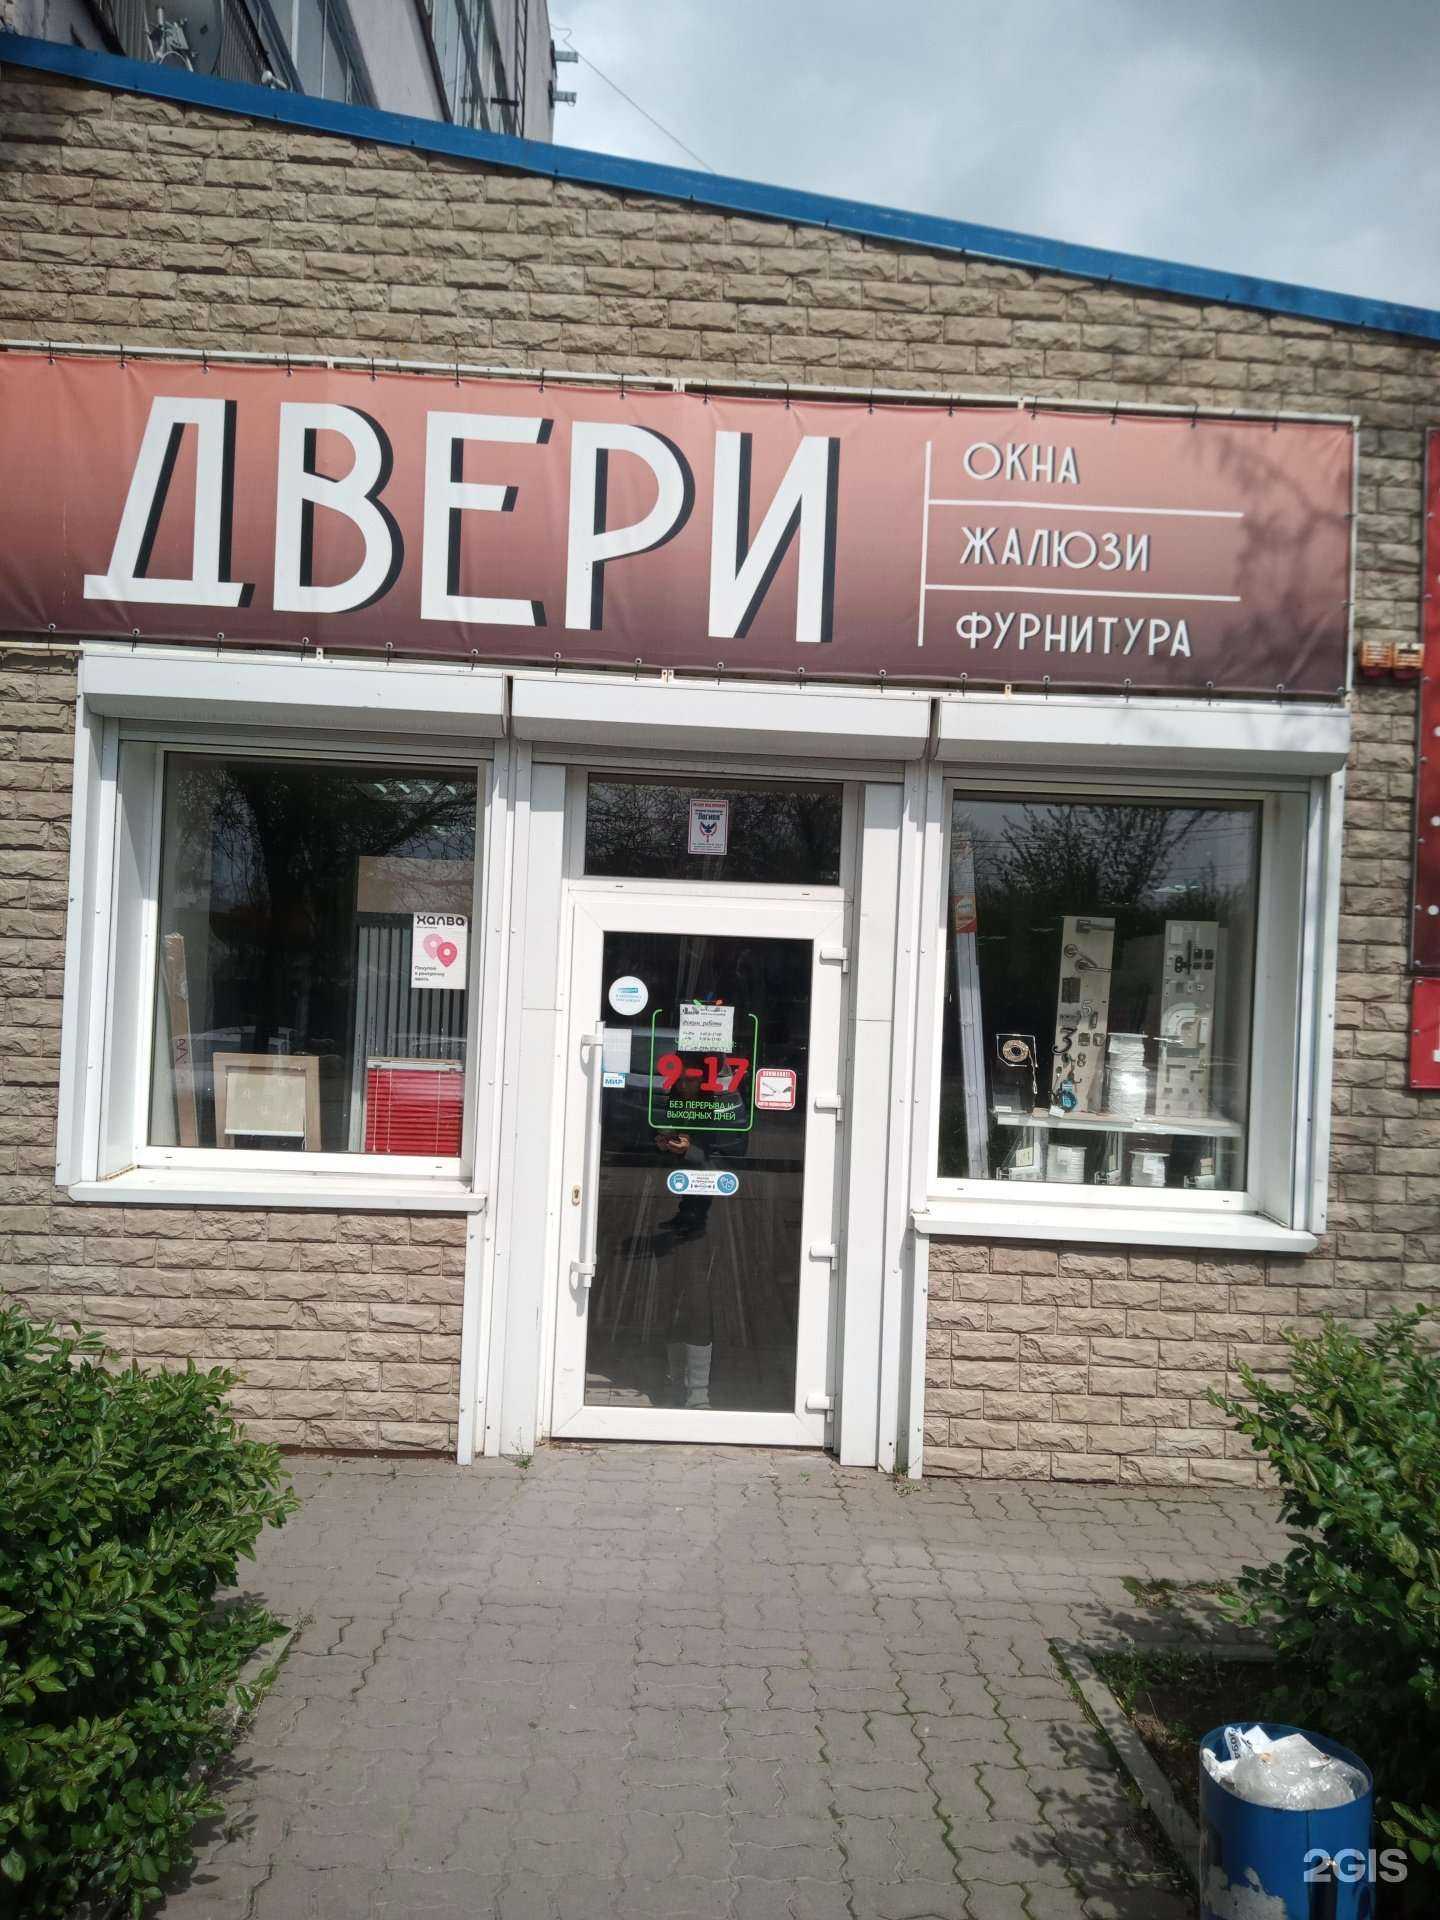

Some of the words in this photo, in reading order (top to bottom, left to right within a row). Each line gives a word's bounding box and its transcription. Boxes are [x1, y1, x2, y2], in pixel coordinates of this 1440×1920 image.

[962, 442, 1079, 485] ОКНА
[83, 396, 840, 643] ДВЕРИ
[959, 526, 1151, 572] ЖАЛЮЗИ
[956, 612, 1191, 657] ФУРНИТУРА
[656, 1053, 750, 1093] 9-17
[666, 1110, 712, 1120] ВЫХОДНЫХ
[713, 1111, 736, 1121] ДНЕЙ
[669, 1100, 684, 1109] БЕЗ
[685, 1101, 725, 1110] ПЕРЕРЫВА
